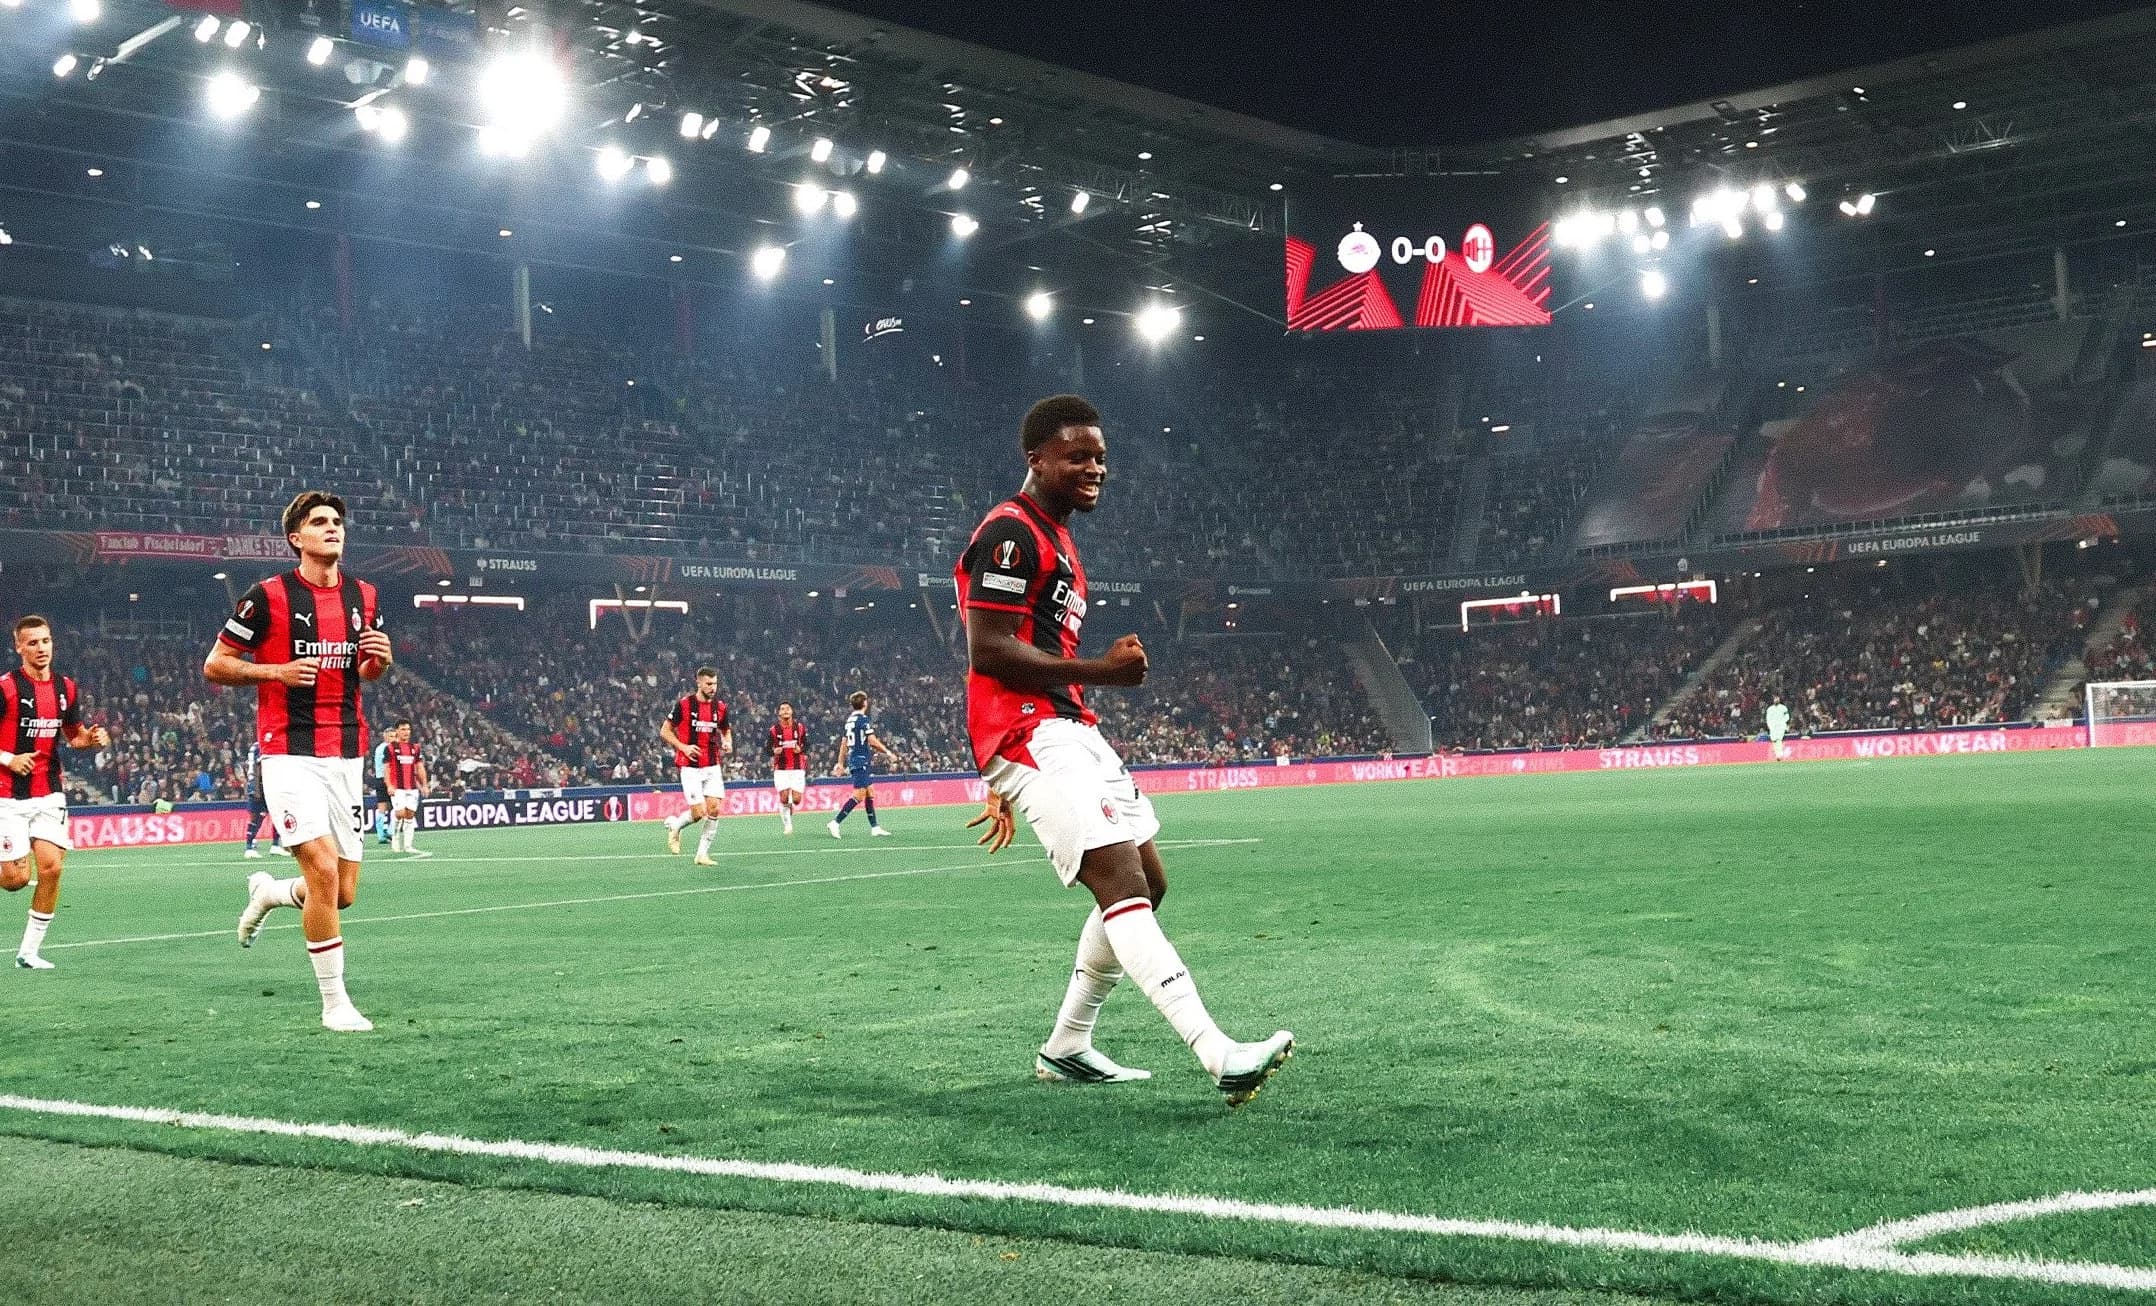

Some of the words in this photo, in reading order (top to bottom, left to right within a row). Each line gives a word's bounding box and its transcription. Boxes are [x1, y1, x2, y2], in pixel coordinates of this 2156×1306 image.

[360, 11, 399, 32] UEFA
[1391, 236, 1446, 264] 0-0
[1849, 541, 1879, 553] UEFA
[1881, 537, 1929, 551] EUROPA
[1932, 532, 1980, 546] LEAGUE
[488, 558, 537, 571] STRAUSS
[681, 566, 711, 578] UEFA
[712, 566, 755, 579] EUROPA
[756, 568, 797, 580] LEAGUE
[1111, 582, 1141, 593] LEAGUE
[1403, 581, 1434, 591] UEFA
[1436, 578, 1481, 590] EUROPA
[1484, 575, 1526, 587] LEAGUE
[294, 639, 358, 655] Emirates
[1852, 731, 2007, 757] WORKWEAR
[1352, 757, 1457, 780] WORKWEAR
[1599, 747, 1699, 769] STRAUSS
[1187, 768, 1258, 790] STRAUSS
[423, 803, 511, 828] EUROPA
[515, 799, 595, 823] LEAGUE
[73, 815, 186, 847] RAUSS
